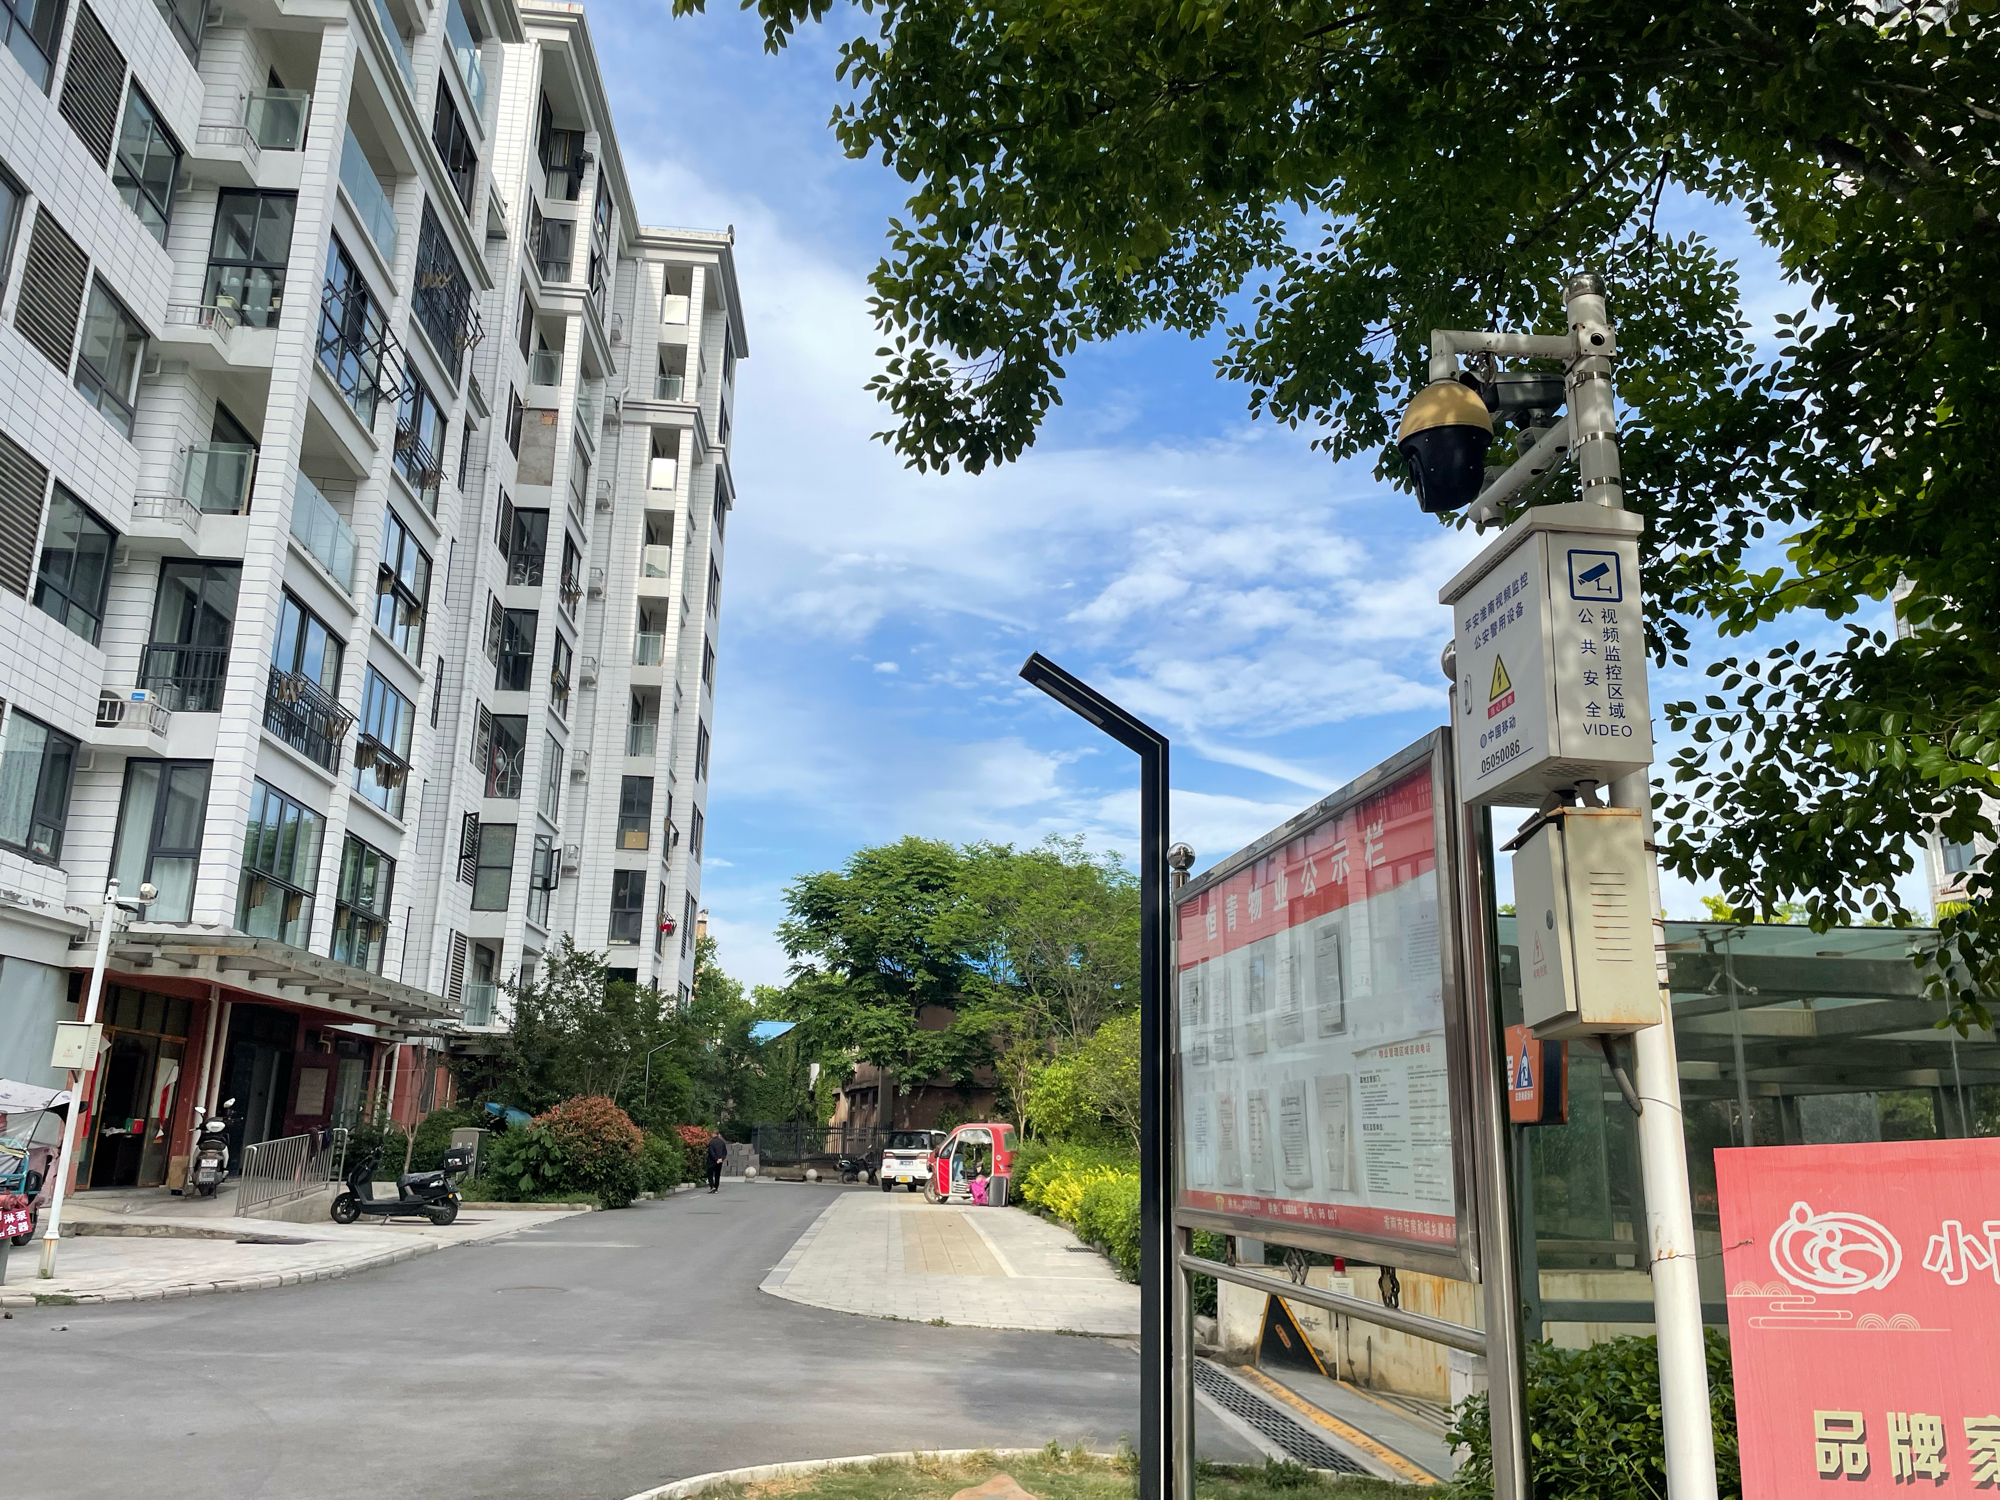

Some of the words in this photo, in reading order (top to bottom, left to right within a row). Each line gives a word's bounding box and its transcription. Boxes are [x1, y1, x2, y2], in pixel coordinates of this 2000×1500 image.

[1464, 571, 1529, 633] 平安淮南视频监控
[1474, 601, 1524, 651] 公安警用设备
[1578, 608, 1601, 718] 公共安全
[1601, 608, 1626, 719] 视频监控区域
[1487, 716, 1516, 743] 中国移动
[1582, 723, 1632, 738] VIDEO
[1481, 739, 1520, 774] 05050086
[1205, 819, 1385, 941] 恒青物业公示栏
[0, 1210, 27, 1224] 淋泵
[0, 1221, 29, 1237] 合器
[1922, 1220, 2000, 1285] 小
